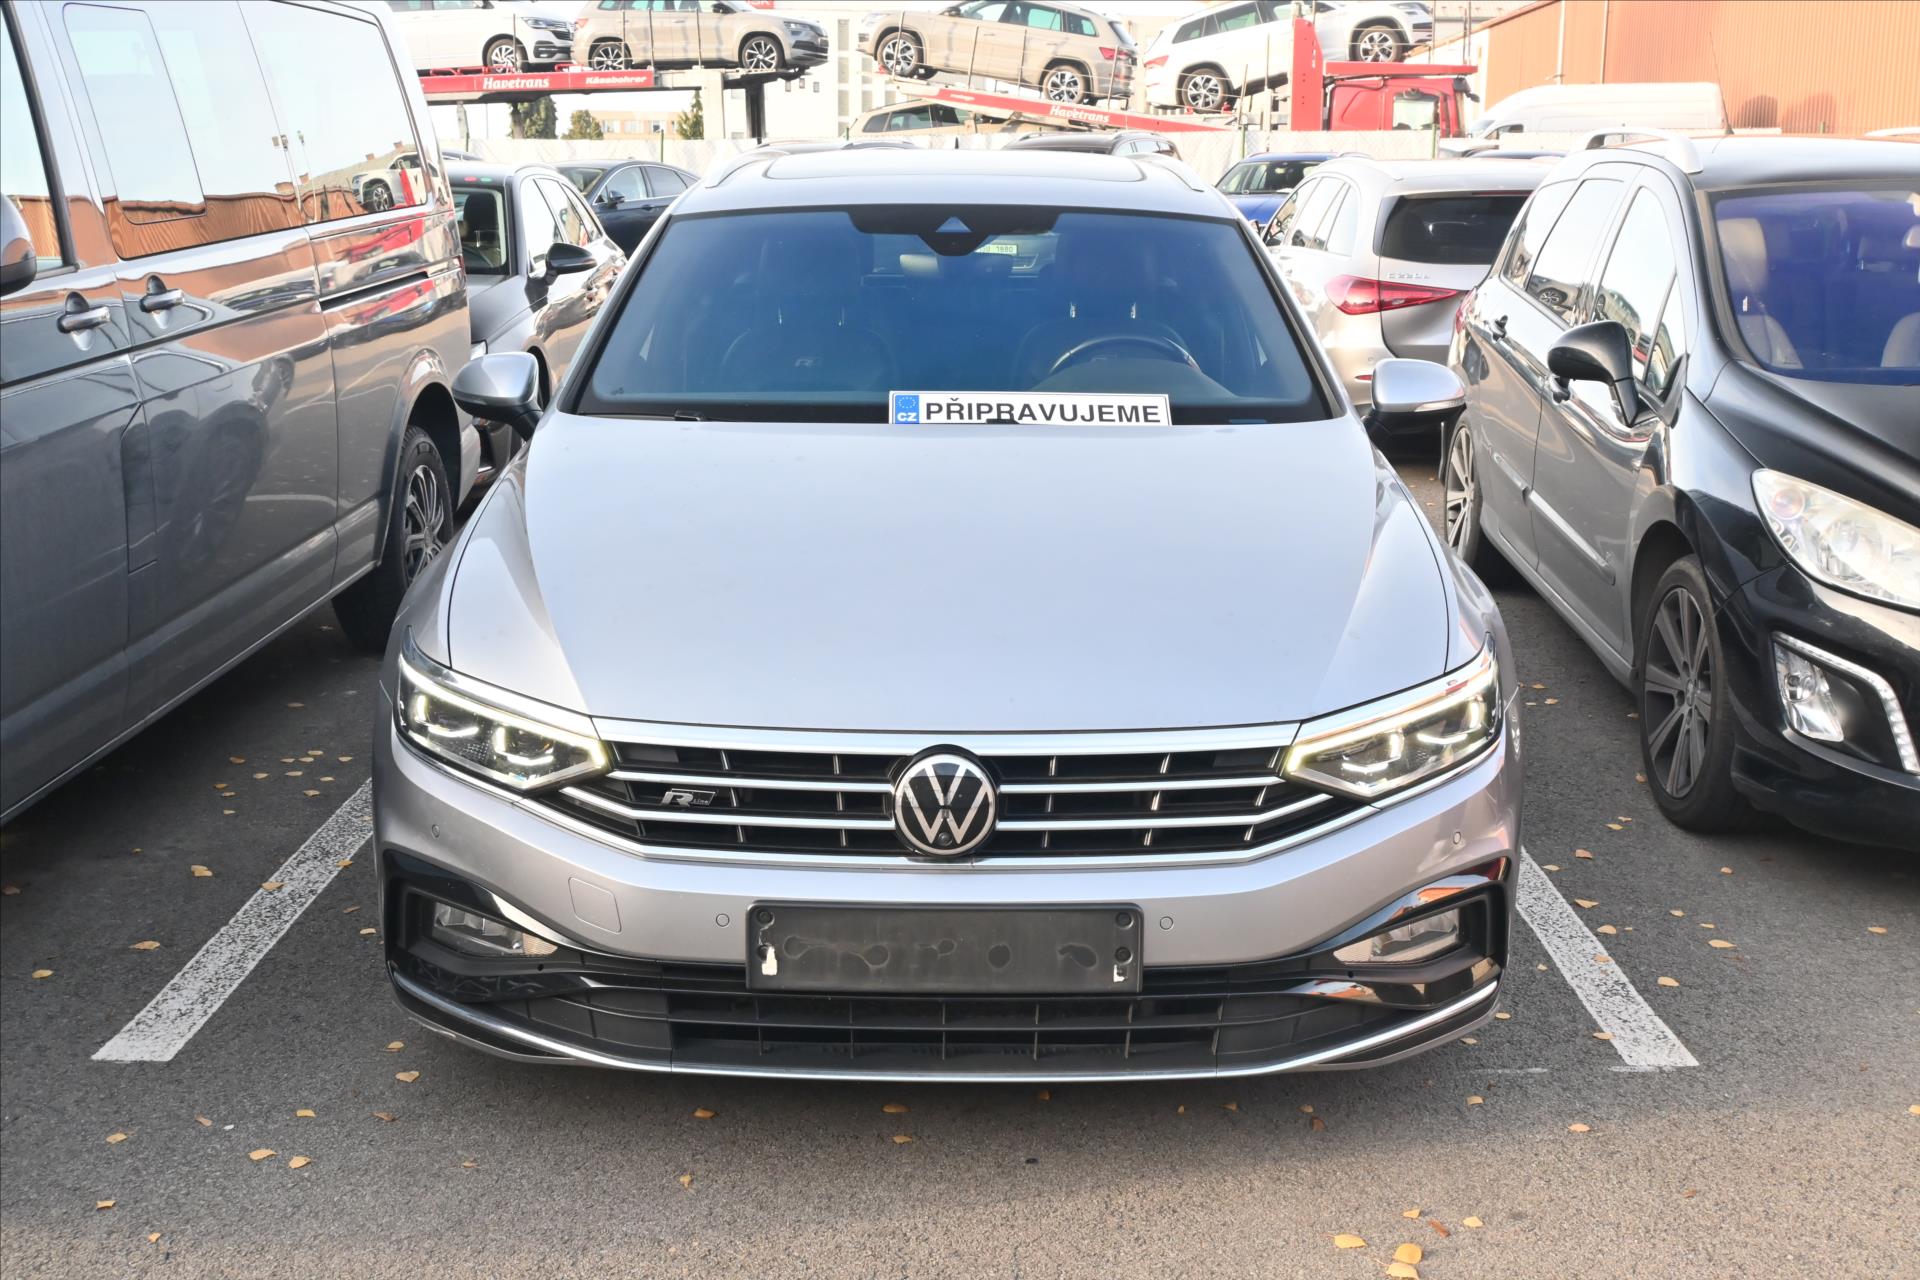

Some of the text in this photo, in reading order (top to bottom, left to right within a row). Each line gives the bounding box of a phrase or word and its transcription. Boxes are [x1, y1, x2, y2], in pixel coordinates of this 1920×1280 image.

[483, 77, 549, 90] Havetrans
[1049, 105, 1110, 123] Havetrans
[896, 411, 918, 423] CZ
[925, 397, 1162, 424] PŘIPRAVUJEME
